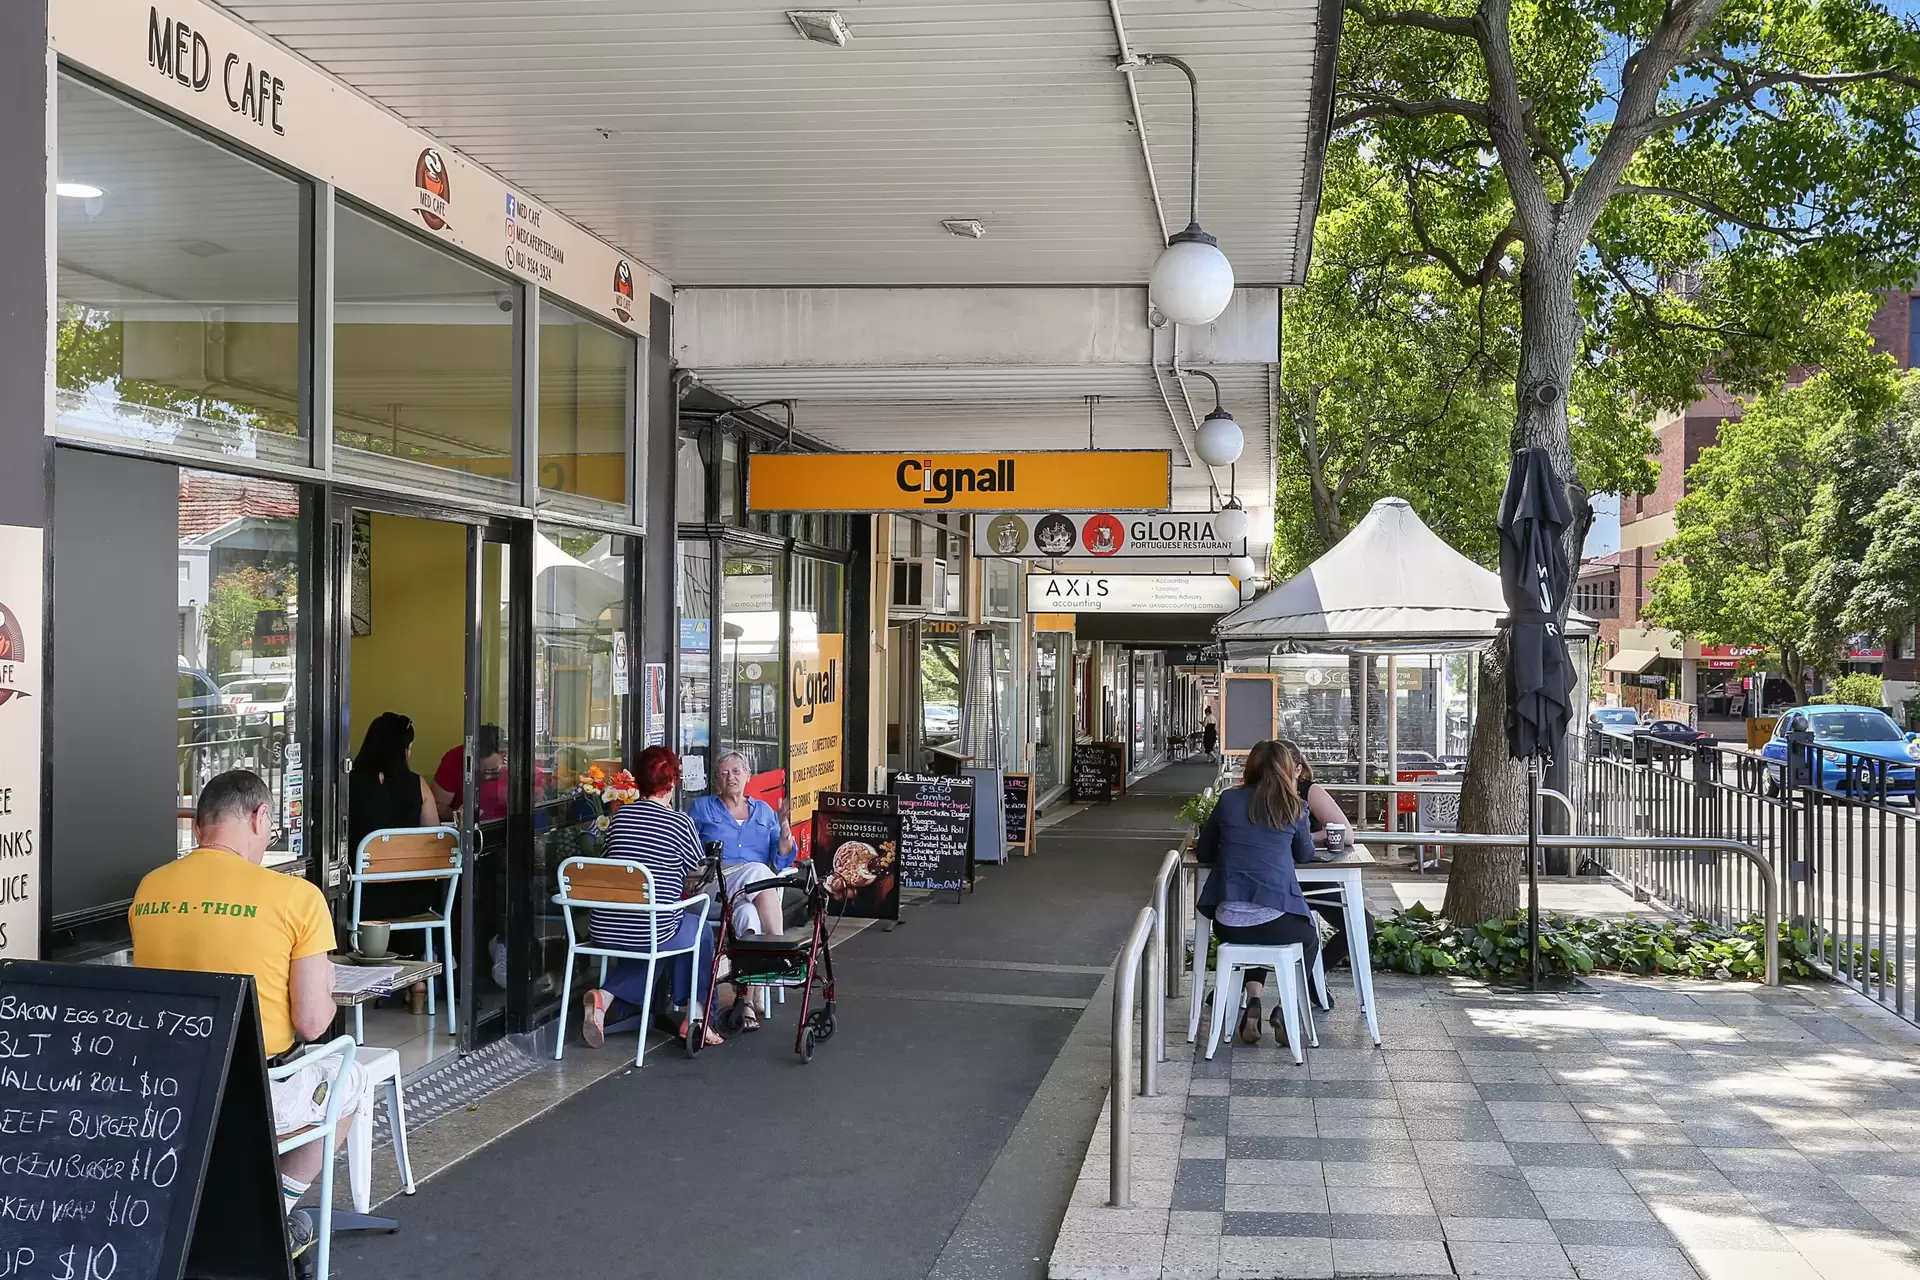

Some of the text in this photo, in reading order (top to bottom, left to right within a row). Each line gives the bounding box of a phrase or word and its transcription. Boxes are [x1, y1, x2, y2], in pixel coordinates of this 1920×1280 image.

[148, 6, 285, 136] MED CAFE
[419, 191, 446, 217] MED CAFE
[517, 201, 541, 228] MED CAFE
[896, 459, 1015, 504] Cignall
[1131, 522, 1216, 541] GLORIA
[1052, 599, 1102, 610] accounting
[793, 659, 835, 724] Cignall
[827, 797, 890, 809] DISCOVER
[916, 793, 950, 801] Combo
[826, 823, 889, 832] CONNOISSEUR
[0, 995, 58, 1021] BACON
[63, 1007, 99, 1024] EGG
[102, 1008, 150, 1030] ROLL
[71, 1031, 114, 1056] $10
[90, 1072, 132, 1093] ROLL
[140, 1070, 179, 1099] $10
[0, 1101, 182, 1141] EEF BURGER $10
[130, 1146, 178, 1188] $10
[106, 1190, 150, 1227] $10
[51, 1242, 118, 1280] $10
